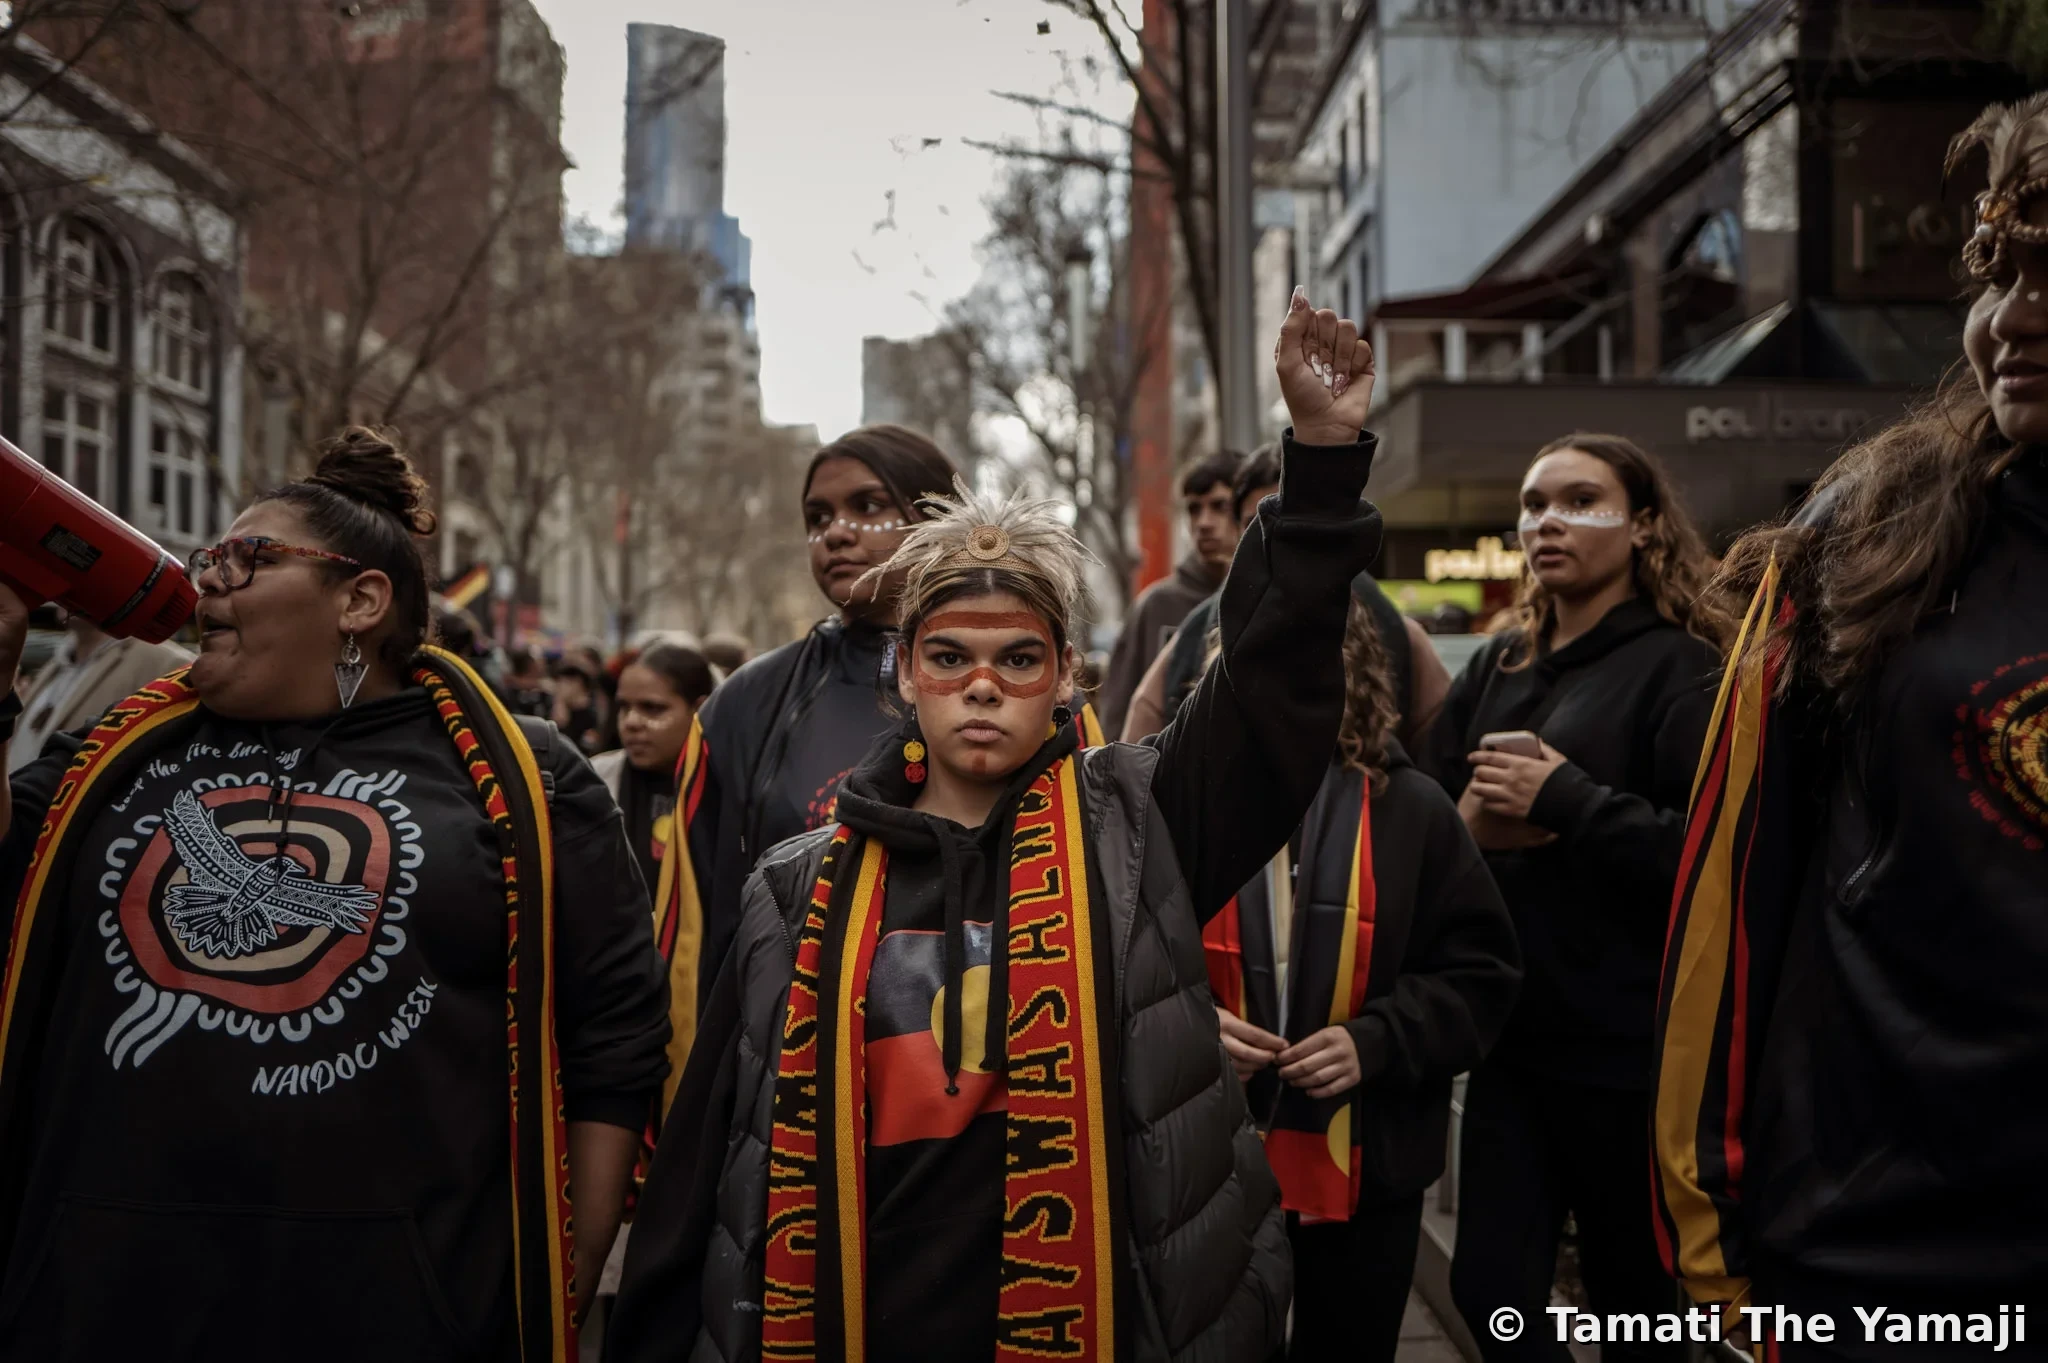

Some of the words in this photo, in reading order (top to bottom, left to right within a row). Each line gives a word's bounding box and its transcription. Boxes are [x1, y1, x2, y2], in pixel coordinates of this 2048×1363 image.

[146, 759, 181, 779] the
[185, 742, 222, 763] fire
[251, 1042, 378, 1096] NAIDOC
[378, 976, 438, 1049] WEEK
